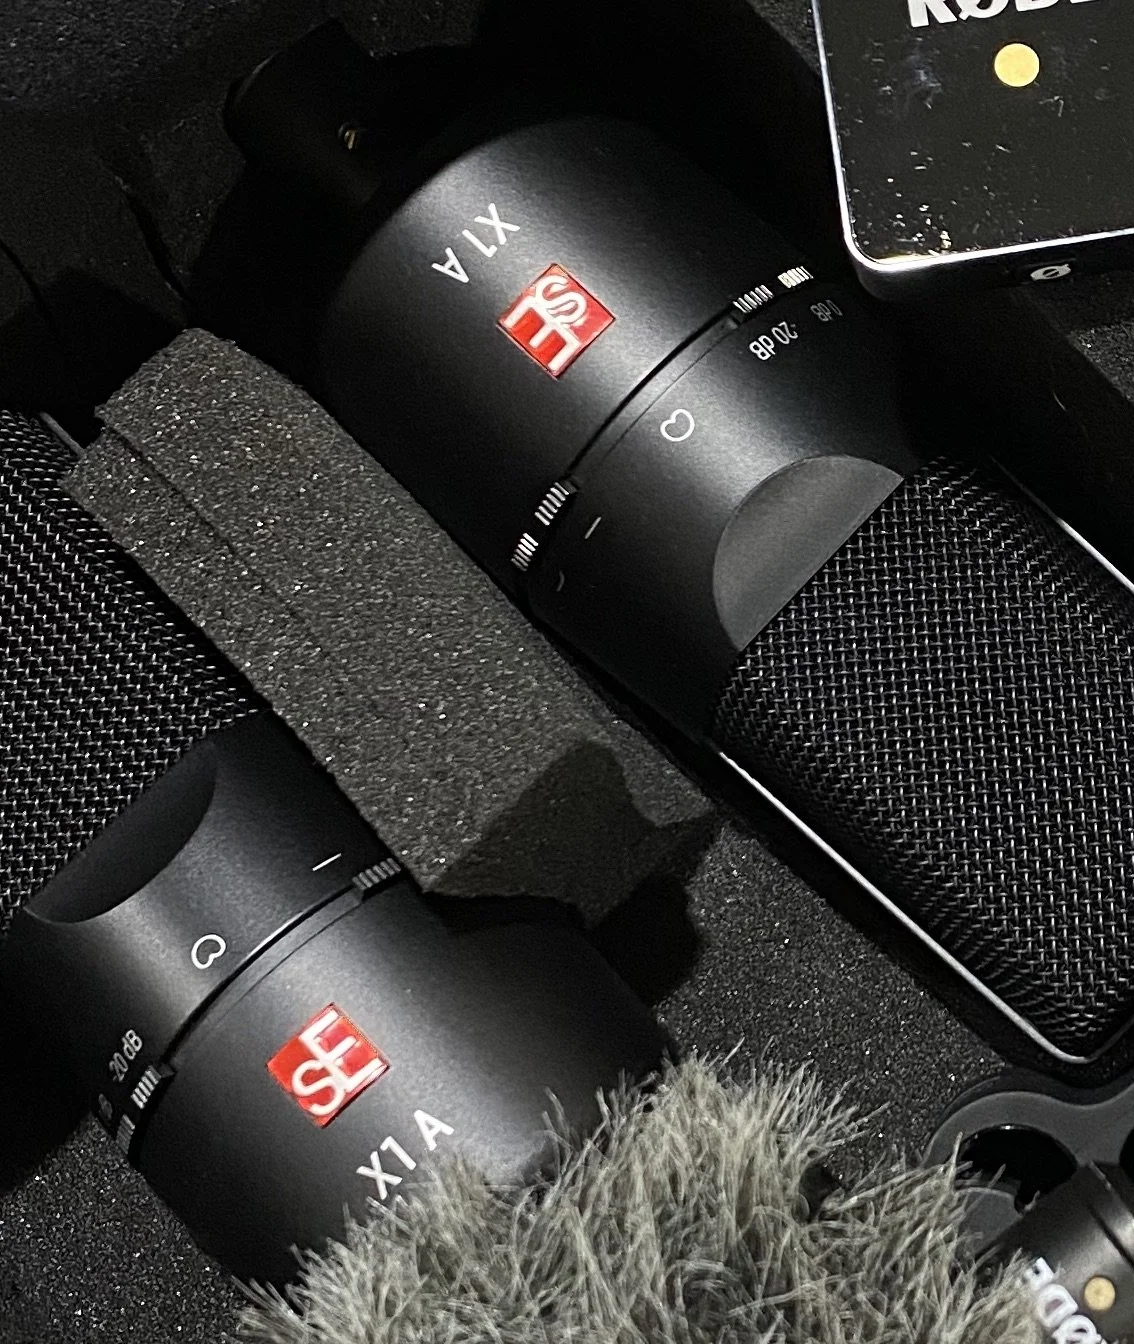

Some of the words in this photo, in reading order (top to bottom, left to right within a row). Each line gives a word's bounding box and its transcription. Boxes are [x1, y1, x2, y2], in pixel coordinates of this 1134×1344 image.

[462, 202, 521, 258] X1
[431, 247, 470, 284] A
[748, 336, 777, 362] dB
[121, 1028, 144, 1063] dB
[355, 1135, 417, 1201] X1
[412, 1109, 456, 1152] A
